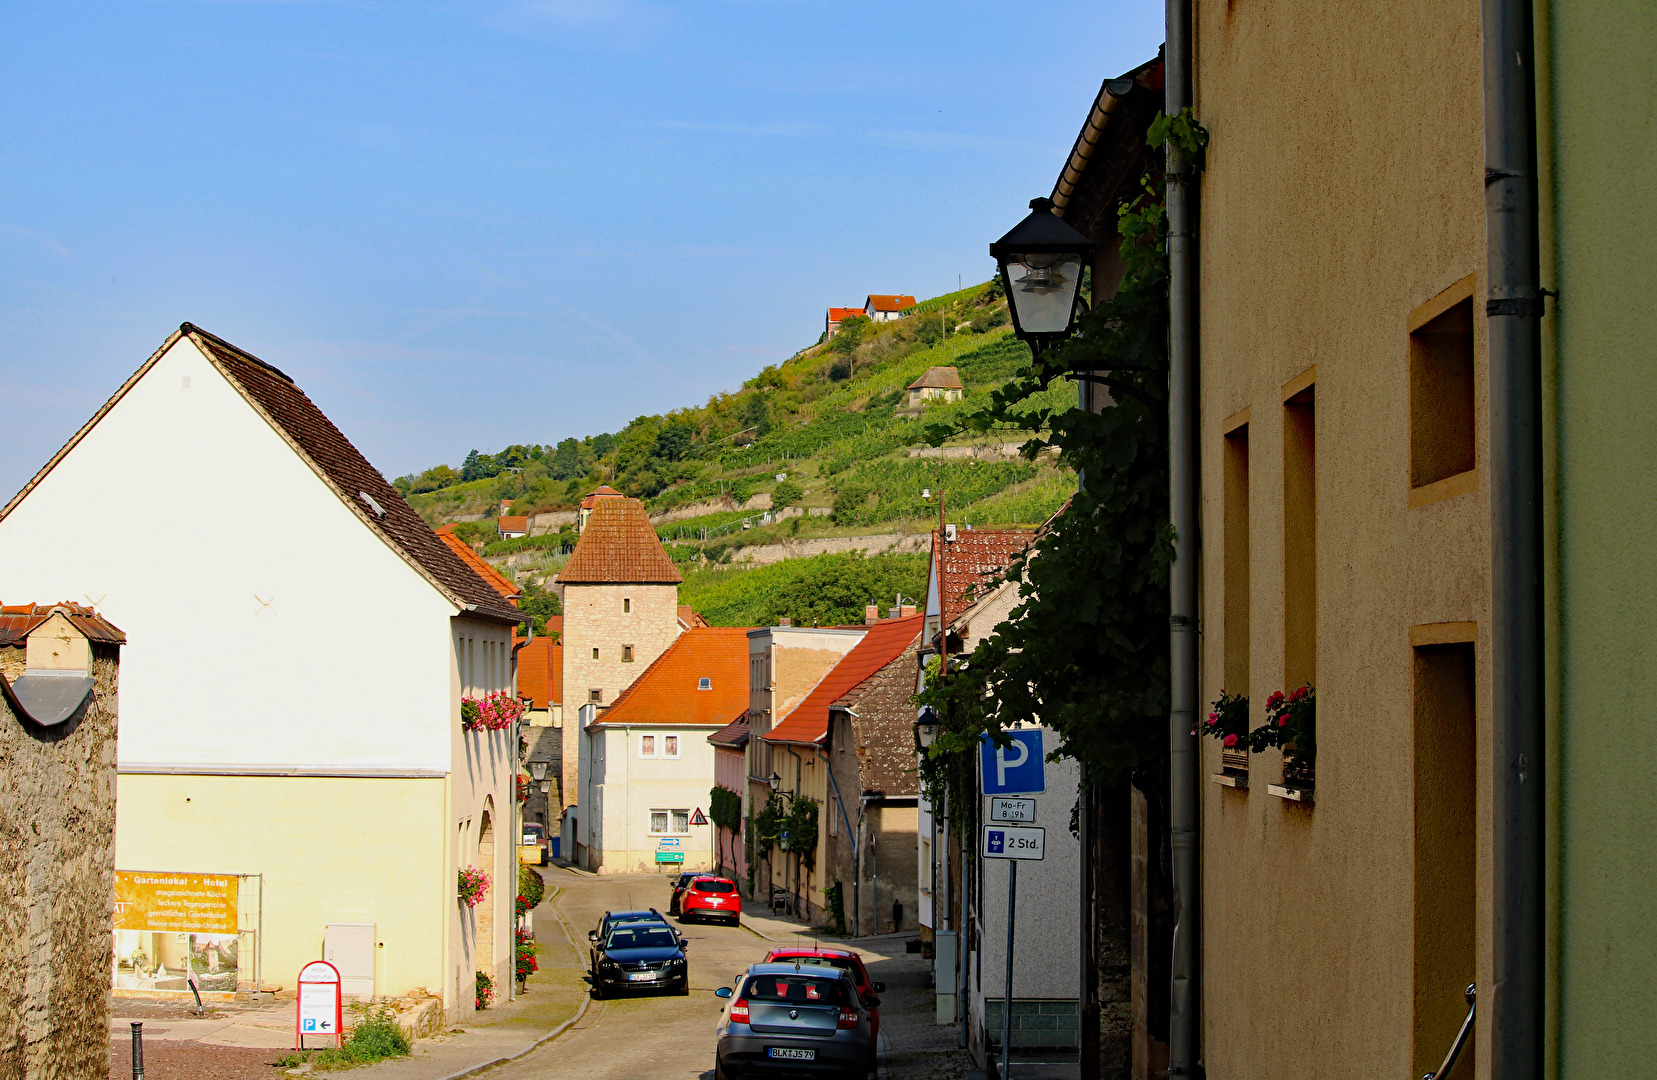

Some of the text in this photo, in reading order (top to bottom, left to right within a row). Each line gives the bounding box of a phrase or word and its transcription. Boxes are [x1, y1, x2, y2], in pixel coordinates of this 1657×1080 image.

[997, 739, 1028, 786] P
[1000, 801, 1026, 810] Mo-Fr
[1008, 837, 1039, 850] 2 Std.
[134, 876, 228, 888] Gartenlokal Hotel
[156, 889, 227, 899] ausgezeichnete Küche
[158, 899, 227, 909] leckere Tagesgerichte
[147, 909, 227, 919] gemütliches Gartenlokal
[147, 919, 168, 928] Weine
[169, 921, 181, 929] von
[305, 1019, 313, 1030] P
[772, 1048, 814, 1059] BLK JS 79
